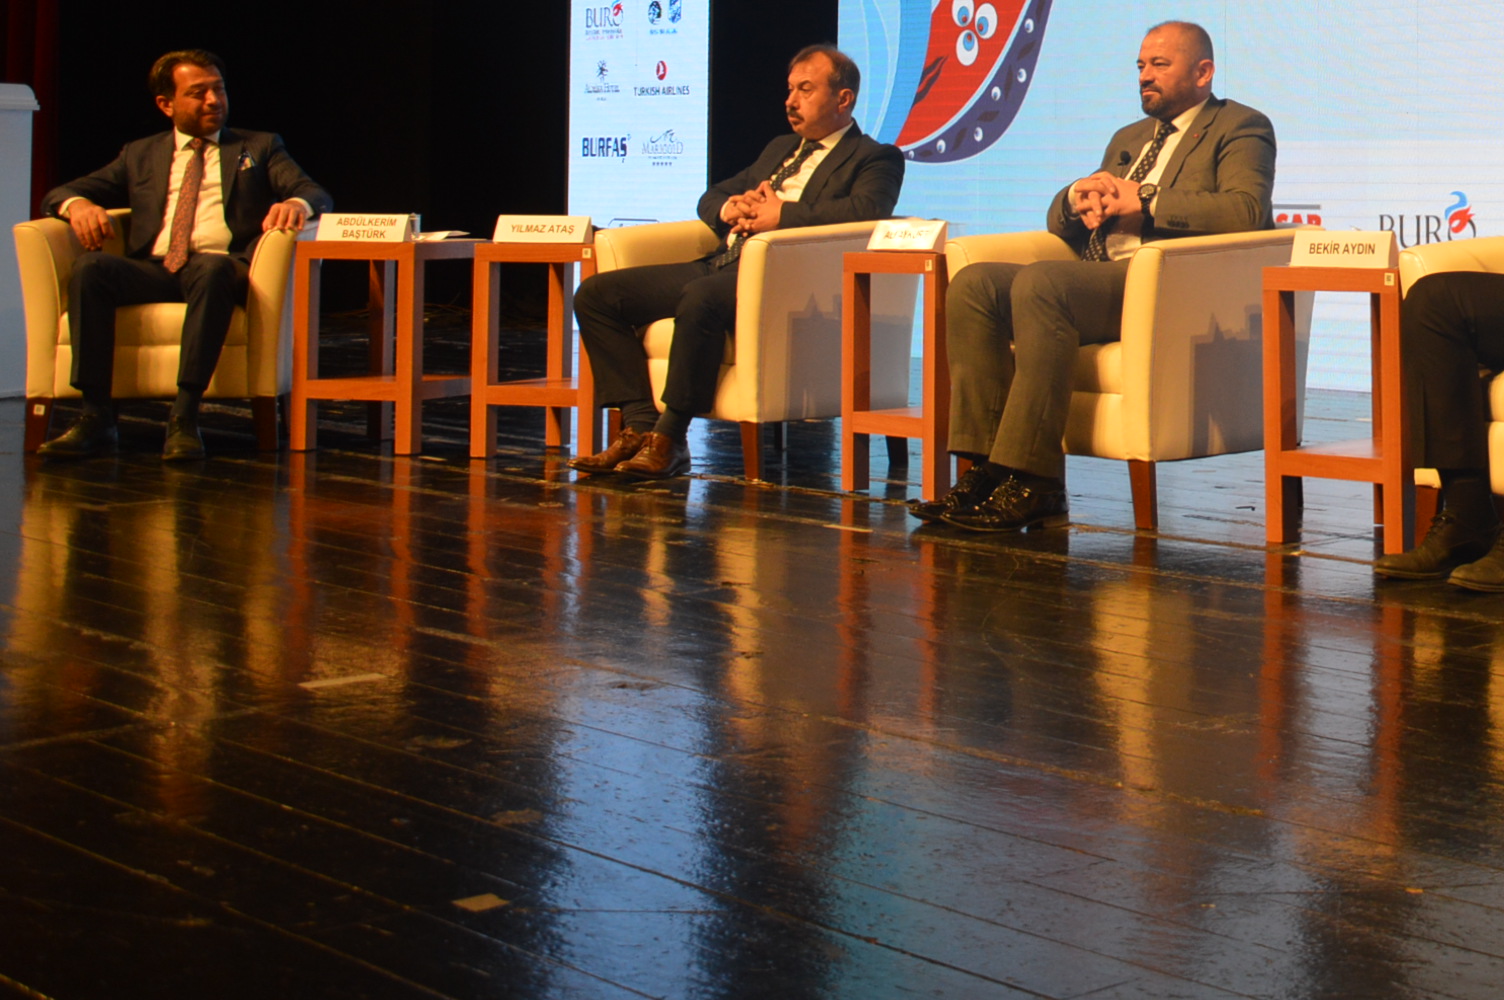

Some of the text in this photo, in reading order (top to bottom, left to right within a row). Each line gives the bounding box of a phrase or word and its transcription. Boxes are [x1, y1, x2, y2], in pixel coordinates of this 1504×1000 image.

[633, 86, 661, 97] TURKISH
[661, 85, 690, 96] AIRLINES
[582, 136, 628, 164] BURFAŞ
[336, 216, 398, 227] ABDÜLKERİM
[341, 227, 387, 240] BAŞTÜRK
[511, 224, 575, 235] YILMAZ ATAŞ
[1309, 240, 1376, 255] BEKİR AYDIN
